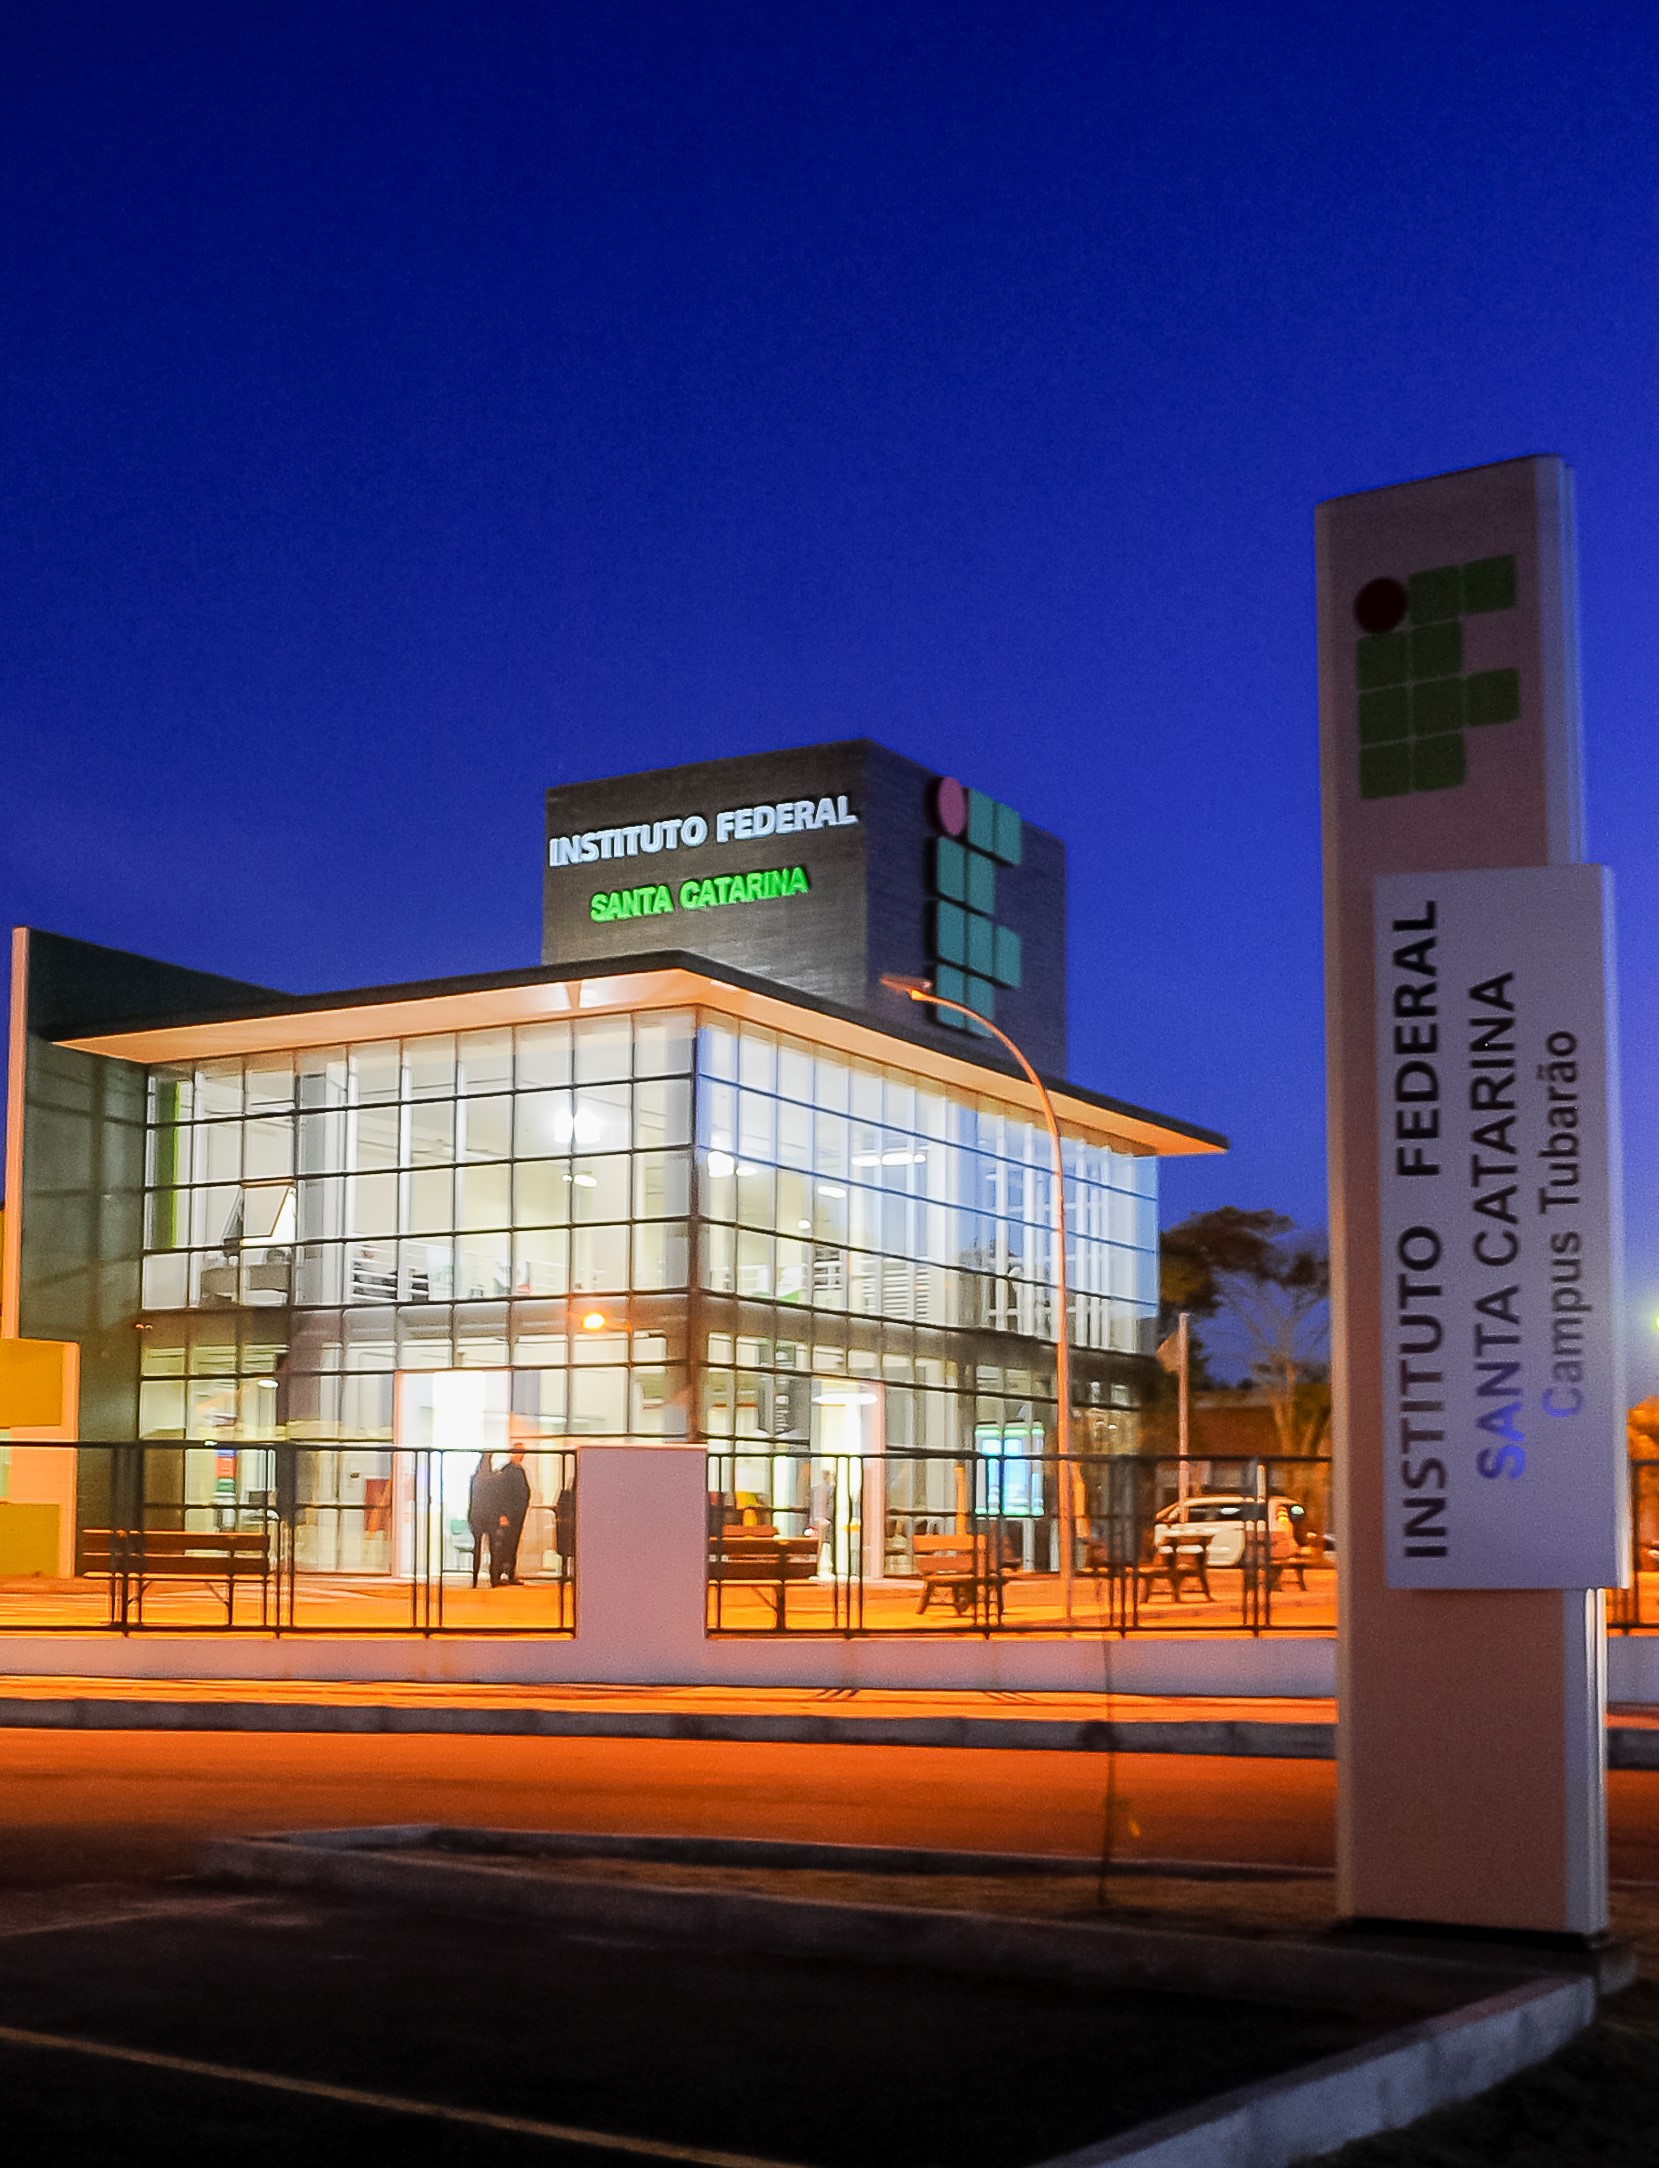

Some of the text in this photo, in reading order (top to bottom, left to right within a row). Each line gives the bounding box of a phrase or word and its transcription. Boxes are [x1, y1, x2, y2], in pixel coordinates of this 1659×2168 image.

[549, 795, 858, 867] INSTITUTO FEDERAL
[590, 866, 808, 922] SANTA CATARINA
[1392, 901, 1448, 1558] INSTITUTO FEDERAL
[1468, 972, 1526, 1480] SANTA CATARINA
[1537, 1031, 1592, 1418] Campus Tubarão
